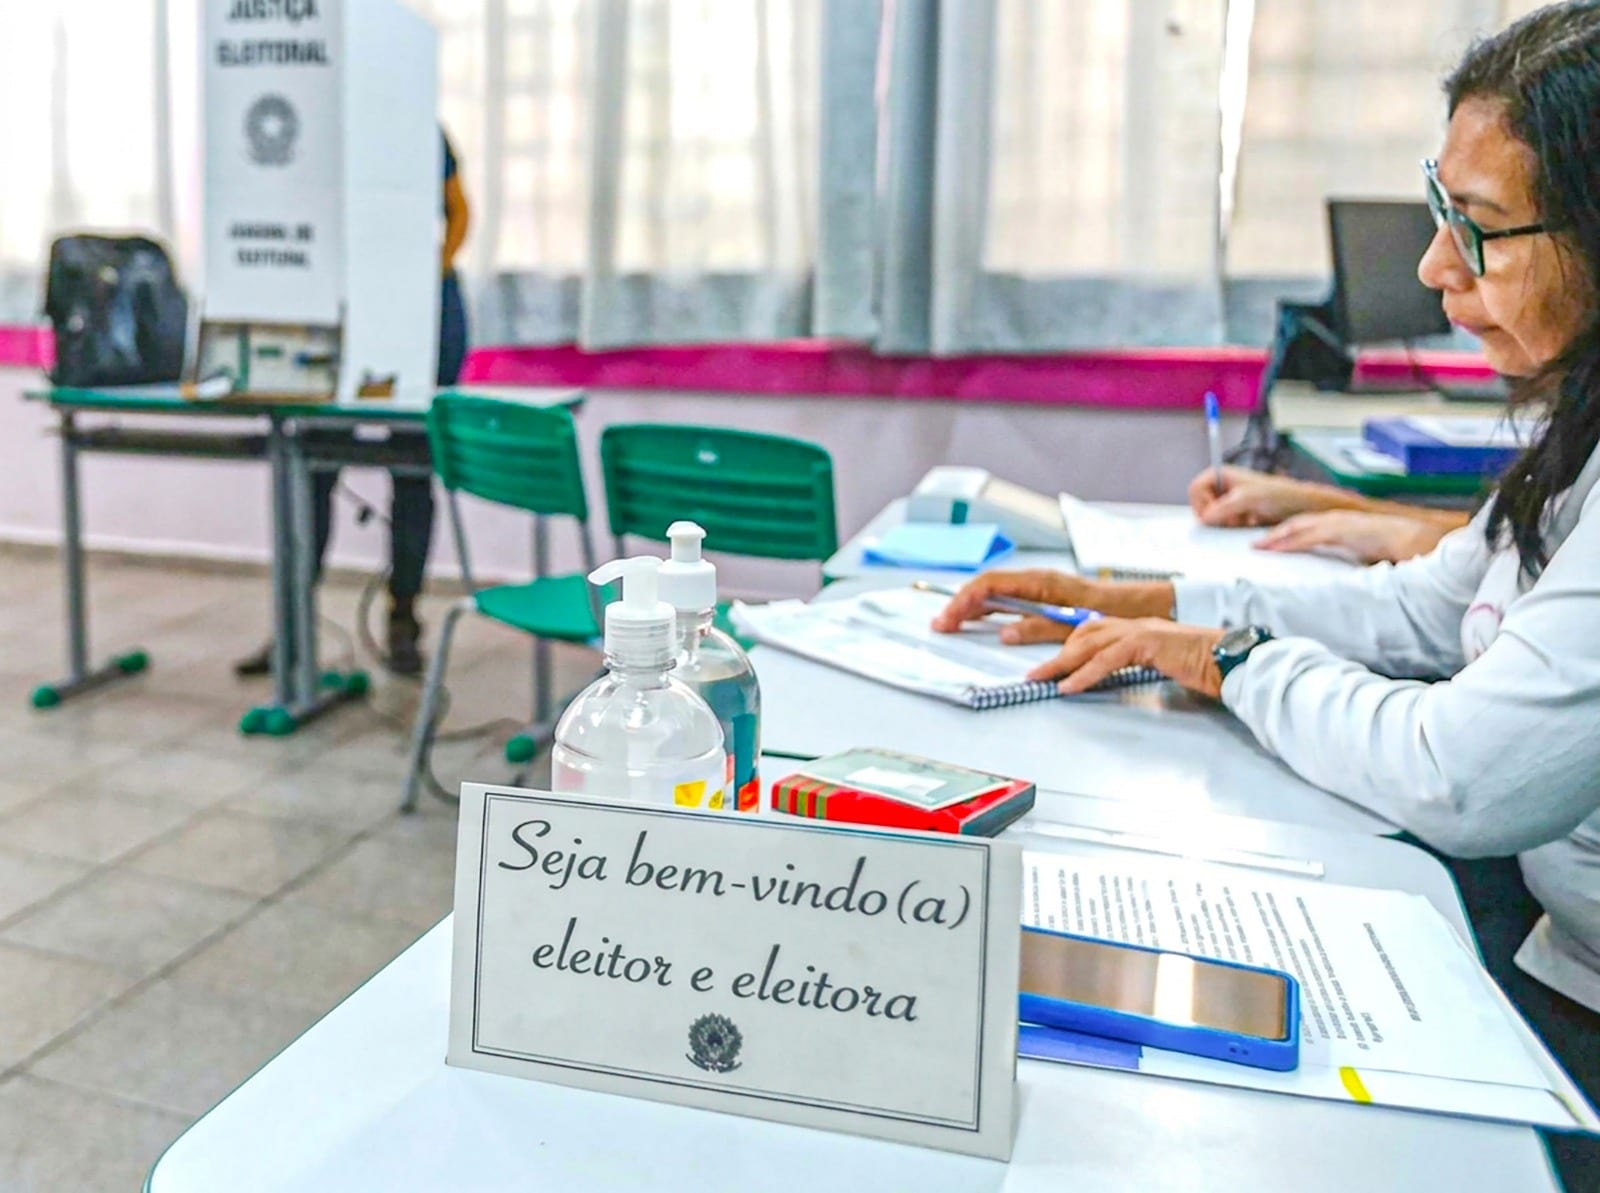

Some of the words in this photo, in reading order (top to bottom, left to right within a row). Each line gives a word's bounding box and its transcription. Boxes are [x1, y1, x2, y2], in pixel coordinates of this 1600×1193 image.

[497, 819, 608, 890] Seja
[624, 829, 971, 930] bem-vindo(a)
[531, 916, 673, 988] eleitor
[689, 966, 715, 993] e
[730, 942, 919, 1023] eleitora
